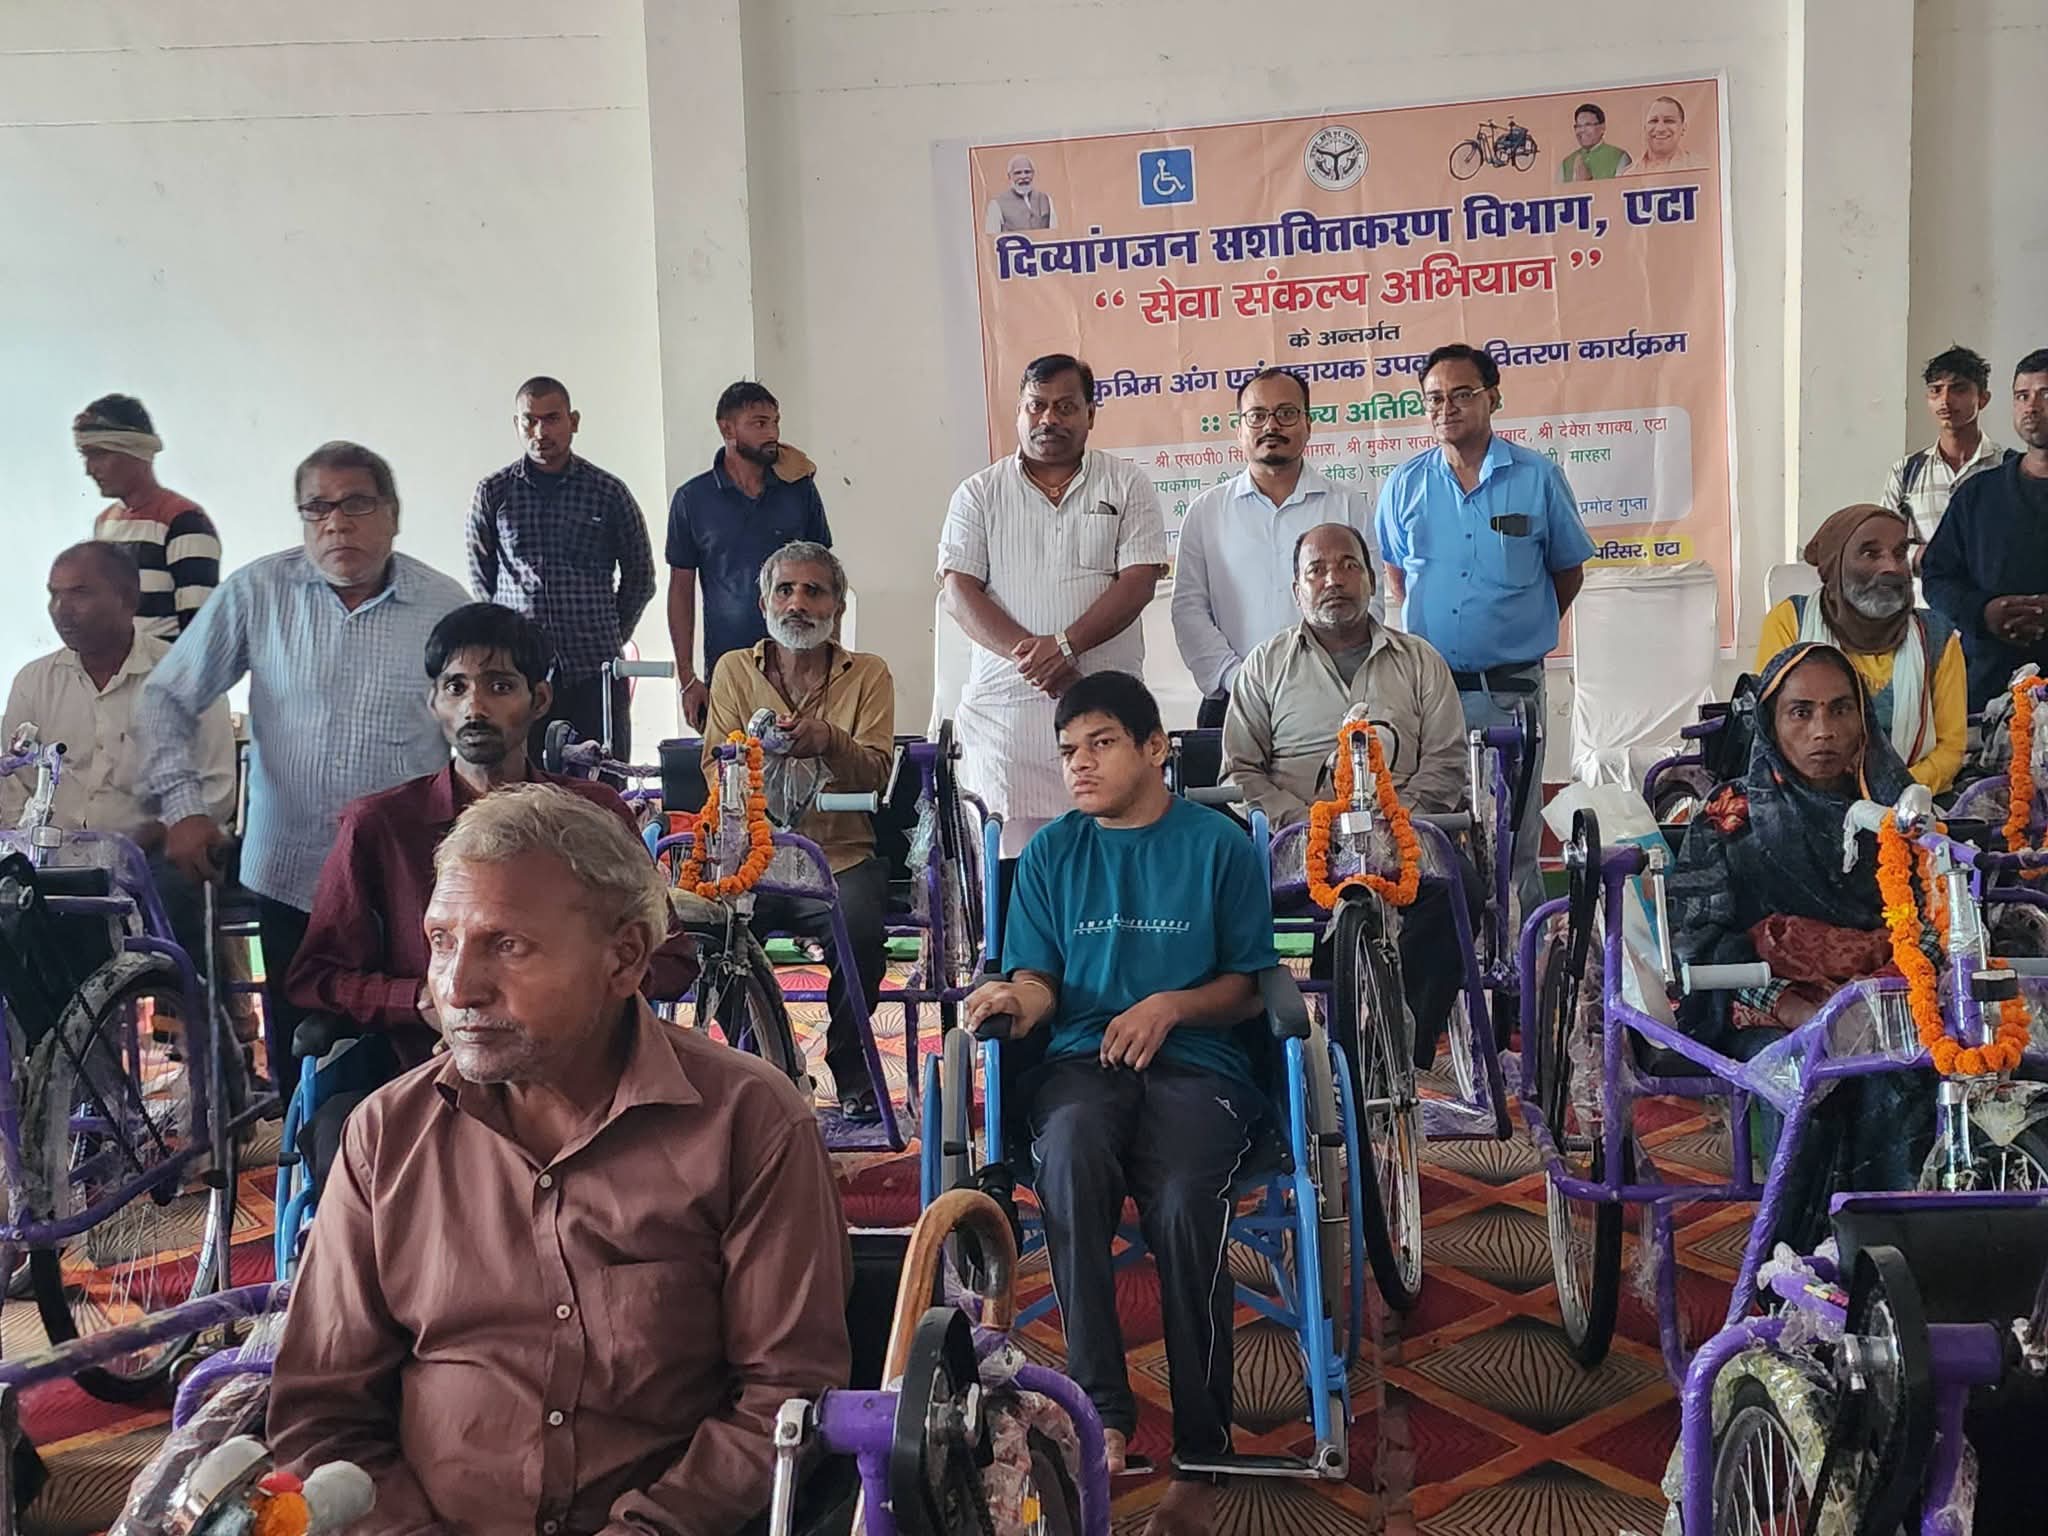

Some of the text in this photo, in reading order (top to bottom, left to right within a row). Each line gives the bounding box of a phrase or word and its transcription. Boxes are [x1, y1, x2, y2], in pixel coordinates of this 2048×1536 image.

[996, 226, 1201, 279] दिव्यांगजन
[1464, 194, 1608, 240] विभाग,
[1623, 185, 1699, 225] एटा
[1140, 278, 1223, 324] सेवा
[1232, 267, 1370, 317] संकल्प
[1380, 252, 1557, 304] अभियान
[1288, 320, 1402, 348] के अन्तर्गत
[1170, 365, 1218, 394] अंग
[1578, 329, 1689, 361] कार्यक्रम
[1345, 389, 1427, 423] अतिथि
[1155, 450, 1170, 469] श्री
[1346, 436, 1361, 455] श्री
[1366, 433, 1401, 458] मुकेश
[1537, 421, 1553, 440] श्री
[1557, 419, 1591, 439] देवेश
[1643, 417, 1667, 435] एटा
[1579, 496, 1649, 517] प्रमोद गुप्ता
[1653, 541, 1681, 557] एटा
